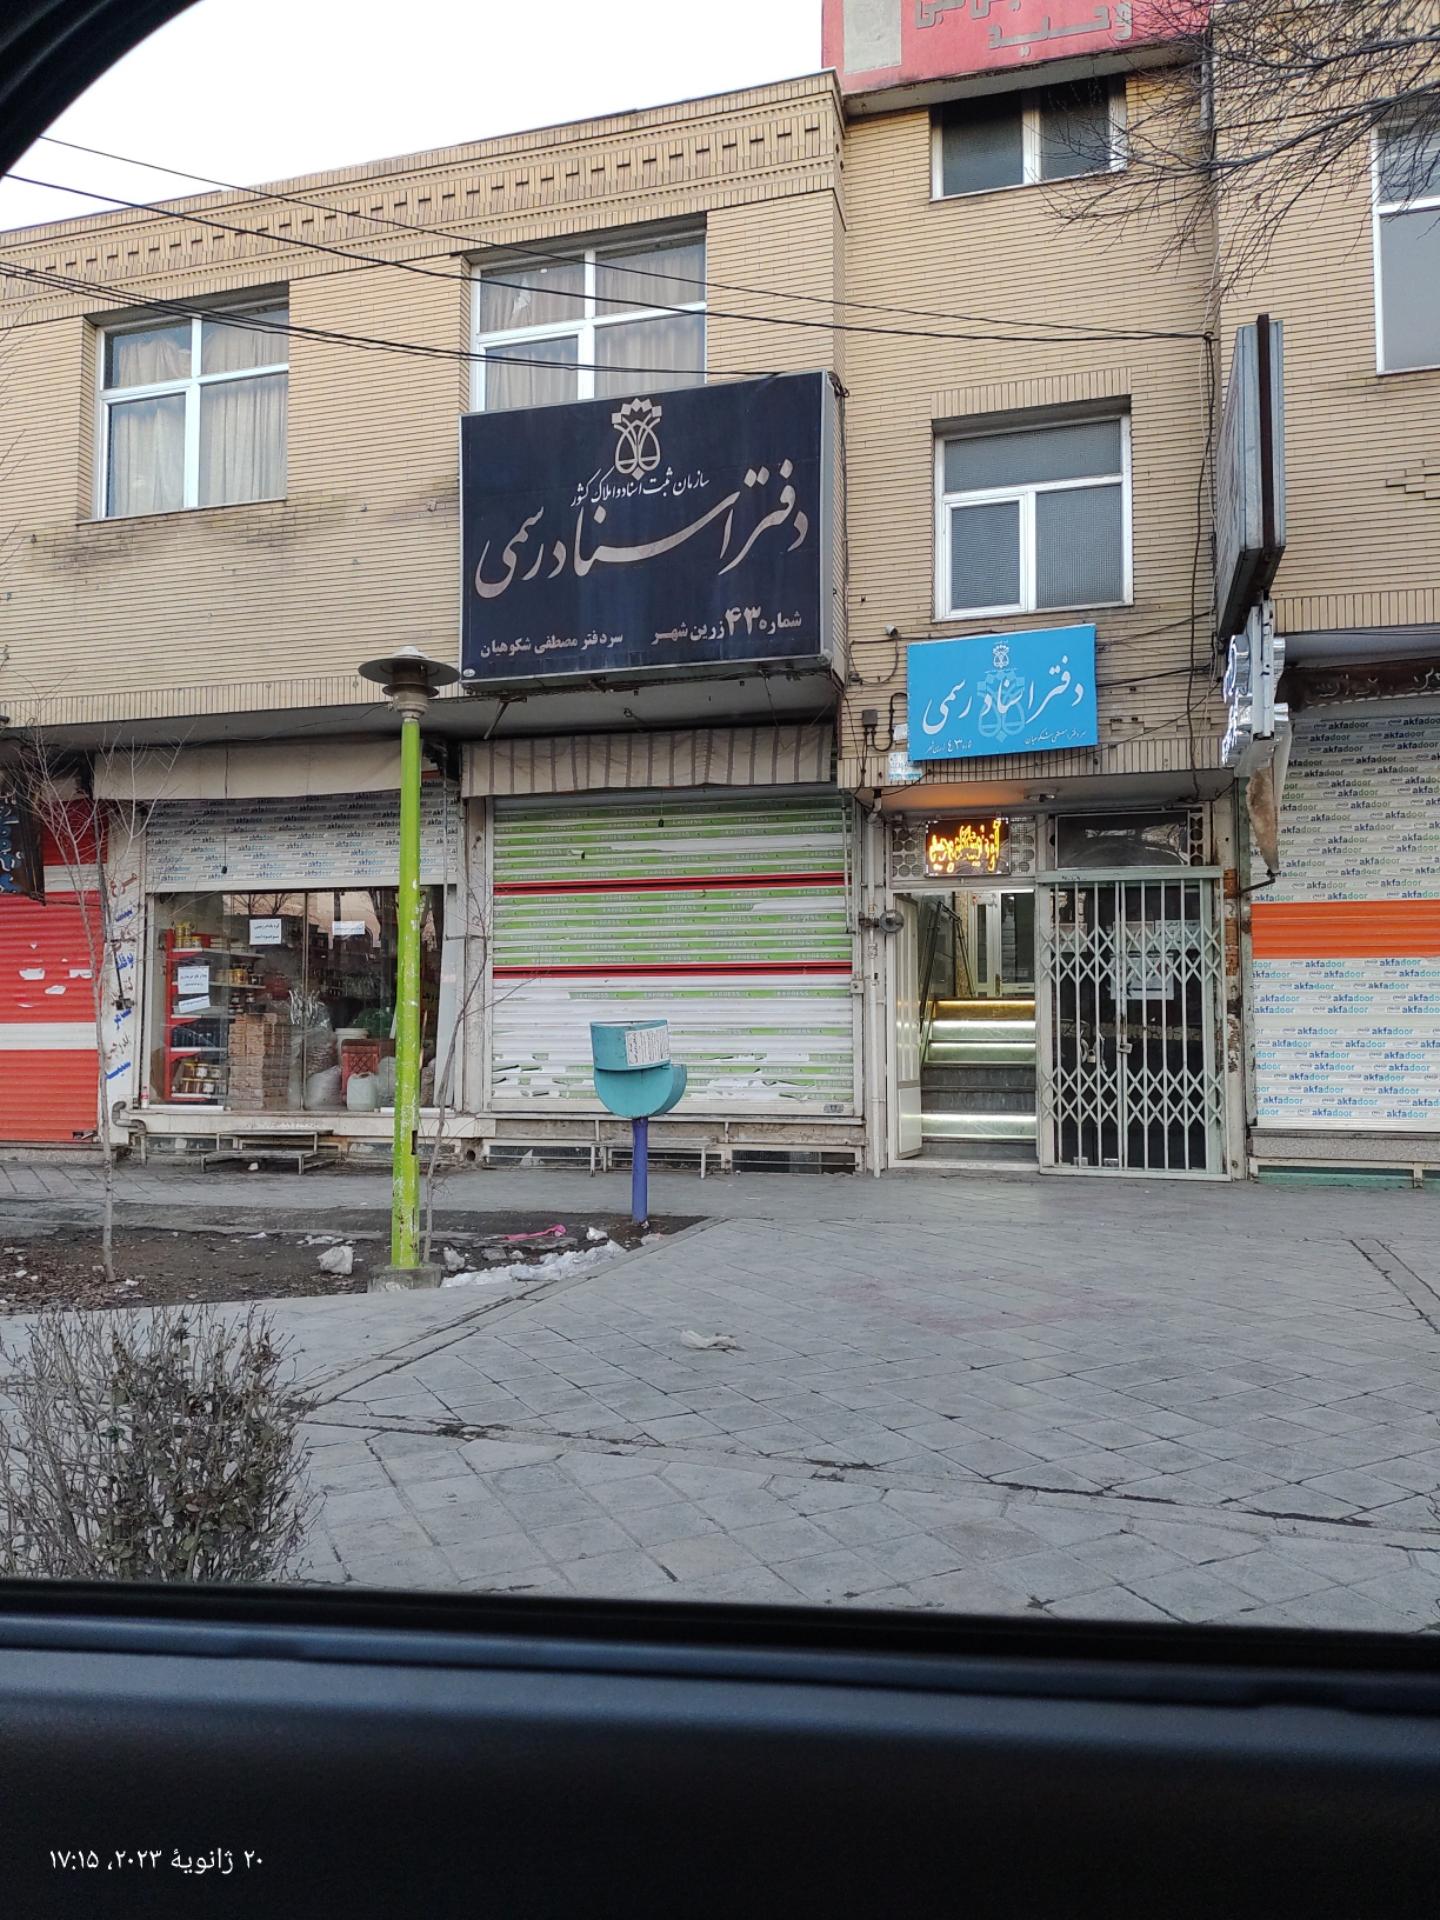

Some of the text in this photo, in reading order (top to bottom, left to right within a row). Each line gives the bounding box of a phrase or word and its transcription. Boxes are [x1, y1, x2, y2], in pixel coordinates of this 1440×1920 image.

[643, 467, 673, 496] ثبت
[673, 470, 709, 495] سازمان
[570, 468, 601, 507] کشور
[475, 458, 808, 599] دفتر اسناد رسمی
[651, 605, 802, 645] شماره ۴۳ زرین شهر
[480, 639, 532, 658] شکوهیان
[535, 635, 578, 654] مصطفی
[922, 655, 1084, 735] دفتر اسناد رسمی
[1403, 718, 1440, 726] akfadoo
[1288, 759, 1323, 767] kfadoor
[1405, 776, 1440, 785] akfadoo
[1282, 792, 1304, 800] door
[1413, 786, 1440, 795] akfad
[1402, 833, 1440, 842] akfadoo
[1415, 866, 1440, 875] akfad
[1402, 890, 1440, 899] akfadoo
[1305, 960, 1345, 968] akfadoor
[1380, 959, 1421, 967] akfadoor
[1324, 970, 1365, 978] akfadoor
[1399, 969, 1440, 978] akfadoor
[1294, 982, 1410, 990] akfadoor akfadoor
[1260, 994, 1440, 1003] akfadoor akfadoor akfado
[1255, 1005, 1440, 1014] akfadoor akfadoor akfadoo
[1297, 1027, 1414, 1036] akfadoor akfadoor
[1272, 1040, 1440, 1048] akfadoor akfadoor akfa
[1309, 1051, 1350, 1059] akfadoor
[1384, 1051, 1425, 1060] akfadoor
[1257, 1063, 1431, 1072] adoor akfadoor akfadoor
[1289, 1073, 1405, 1082] akfadoor akfadoor
[1303, 1085, 1420, 1095] akfadoor akfadoor
[1263, 1096, 1440, 1107] akfadoor akfadoor akfad
[1312, 1109, 1353, 1117] akfadoor
[1387, 1110, 1428, 1118] akfadoor
